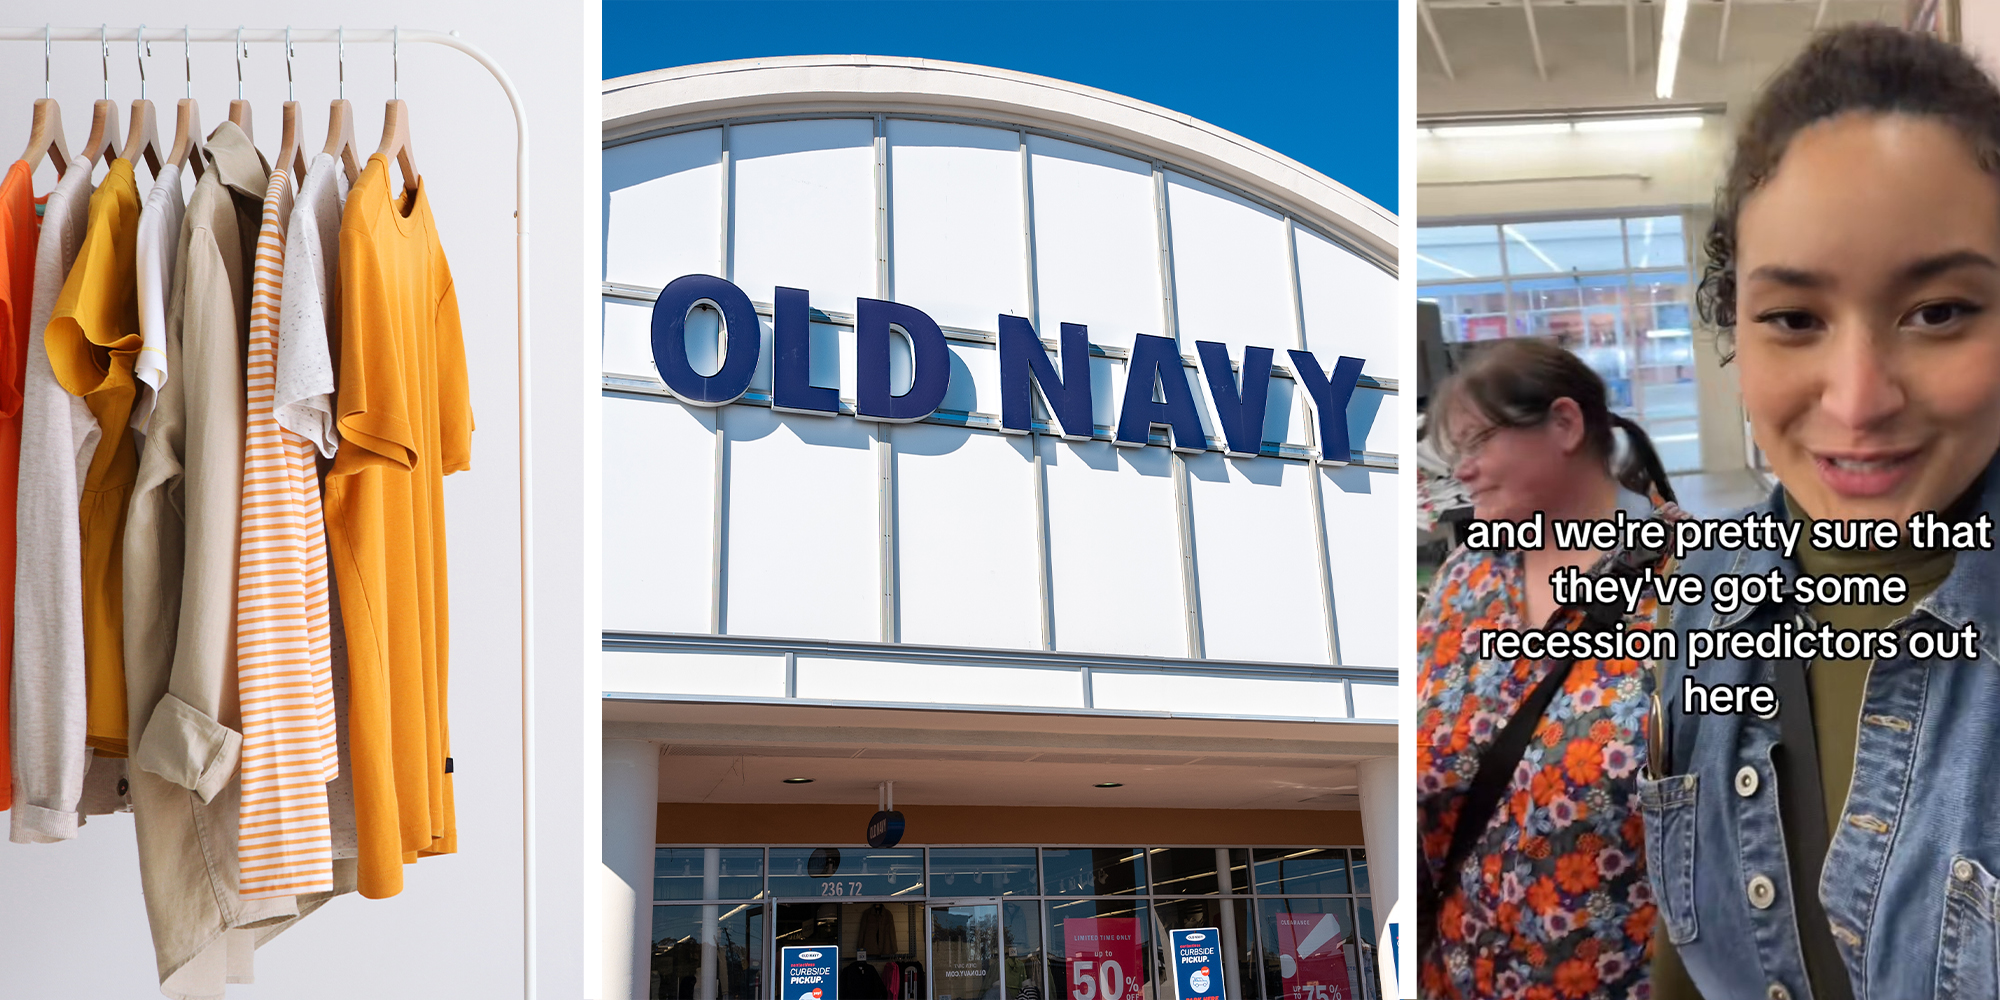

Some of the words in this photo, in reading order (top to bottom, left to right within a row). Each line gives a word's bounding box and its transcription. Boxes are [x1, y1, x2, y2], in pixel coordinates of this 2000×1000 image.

[651, 274, 952, 423] OLD
[998, 313, 1366, 466] NAVY
[821, 882, 843, 896] 236
[849, 882, 863, 896] 72
[1180, 947, 1214, 956] CURBSIDE
[1181, 955, 1210, 964] PICKUP.
[790, 967, 830, 976] CURBSIDE
[790, 976, 824, 984] PICKUP.
